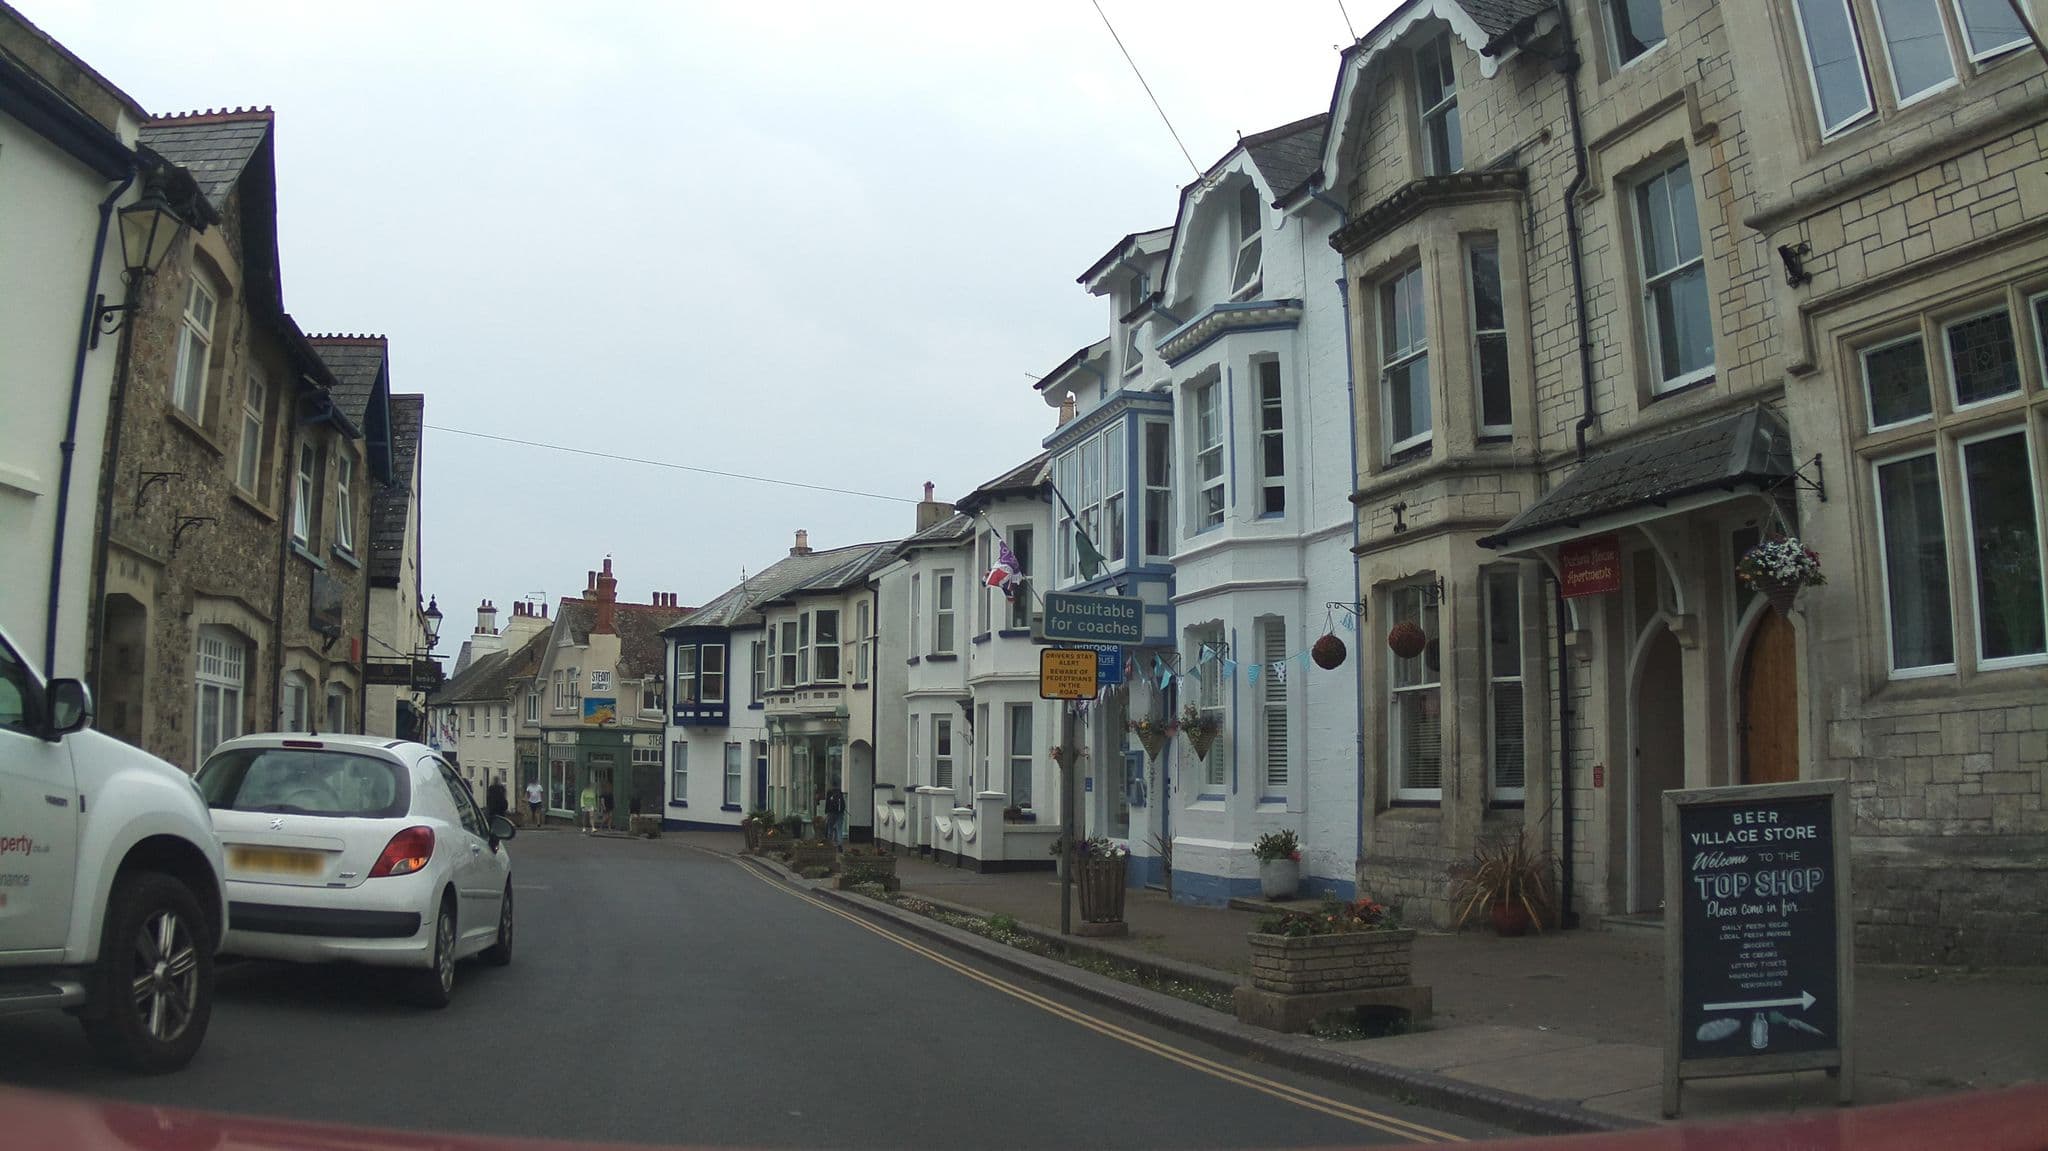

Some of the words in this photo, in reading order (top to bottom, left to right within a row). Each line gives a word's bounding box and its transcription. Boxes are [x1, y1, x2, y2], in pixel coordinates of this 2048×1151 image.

[1567, 566, 1612, 586] Apartments
[1055, 599, 1135, 618] Unsuitable
[1051, 616, 1072, 631] for
[1078, 620, 1138, 635] coaches
[1733, 811, 1779, 825] BEER
[1691, 829, 1759, 845] VILLAGE
[1764, 825, 1817, 841] STORE
[1692, 851, 1749, 871] Welcome
[1758, 852, 1774, 862] TO
[1778, 851, 1801, 861] THE
[1694, 872, 1751, 900] TOP
[1755, 867, 1825, 897] SHOP
[1706, 900, 1738, 918] Please
[1741, 903, 1764, 914] come
[1767, 902, 1777, 913] in
[1781, 897, 1799, 917] for
